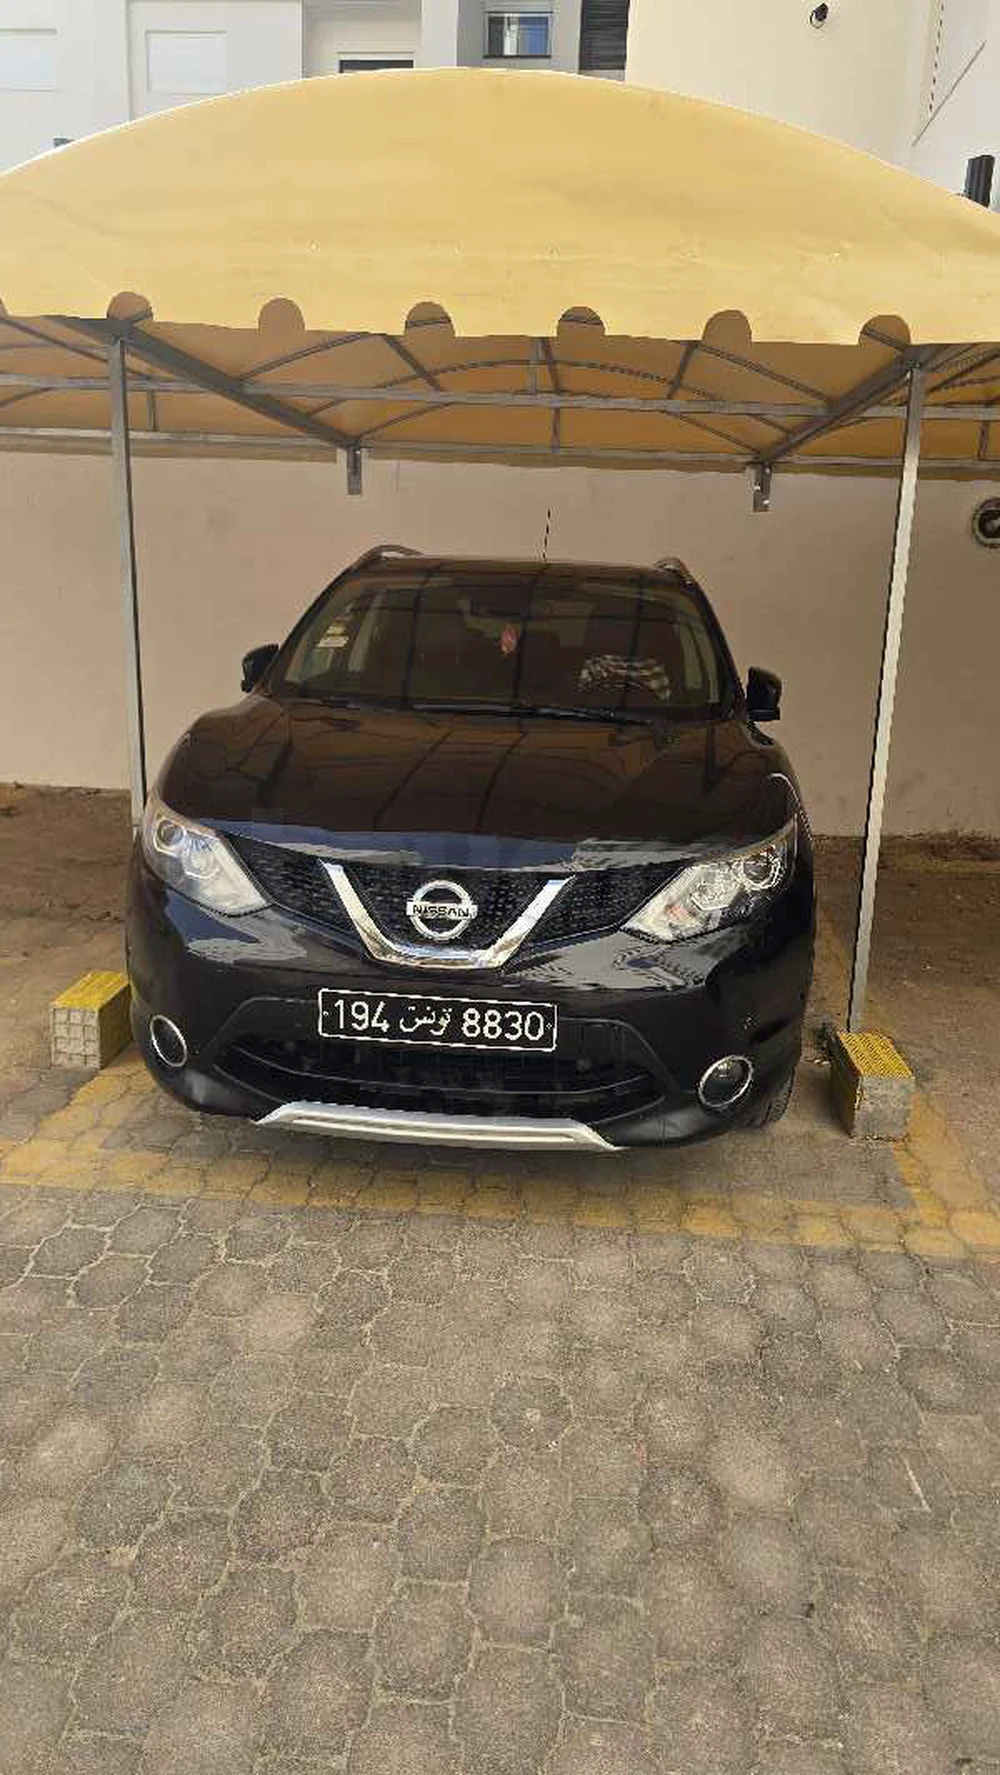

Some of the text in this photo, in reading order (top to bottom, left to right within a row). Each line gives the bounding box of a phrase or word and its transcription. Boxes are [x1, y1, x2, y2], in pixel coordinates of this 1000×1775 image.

[412, 904, 470, 918] NISSAN
[334, 1000, 545, 1041] 194 تونس 8830
